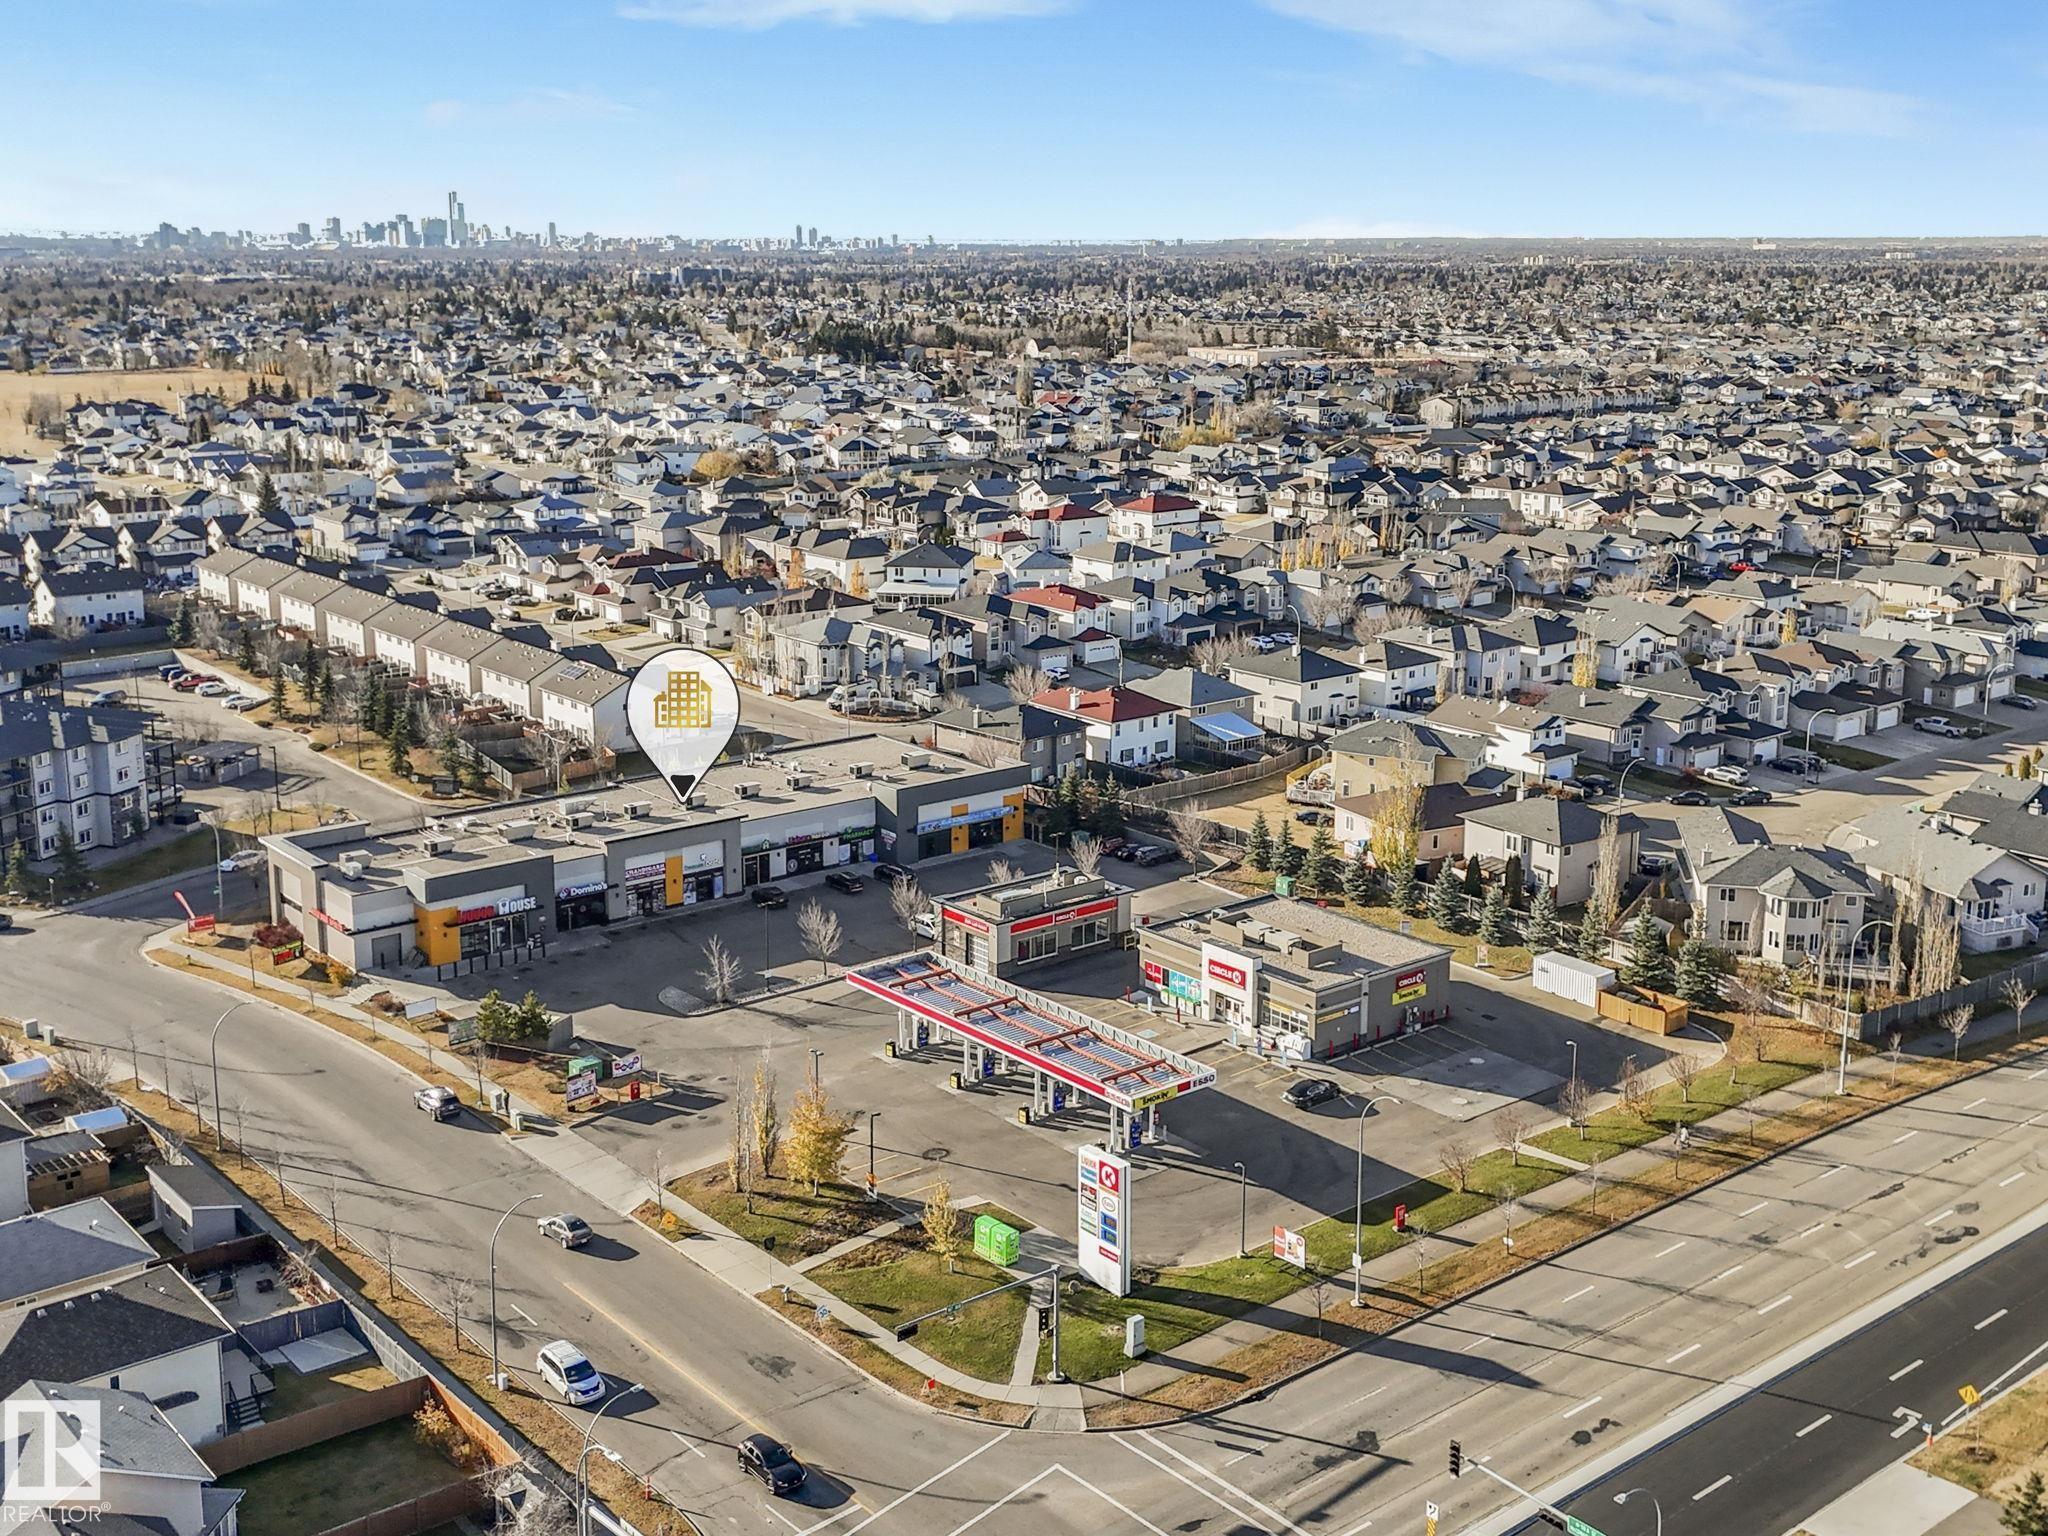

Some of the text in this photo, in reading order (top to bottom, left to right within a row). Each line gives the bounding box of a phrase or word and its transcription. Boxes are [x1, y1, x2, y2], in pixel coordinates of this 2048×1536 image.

[570, 881, 608, 897] Domino's
[1209, 965, 1233, 979] CIRCLE
[1399, 976, 1416, 987] CIRCLE
[1193, 1075, 1215, 1088] ESSO
